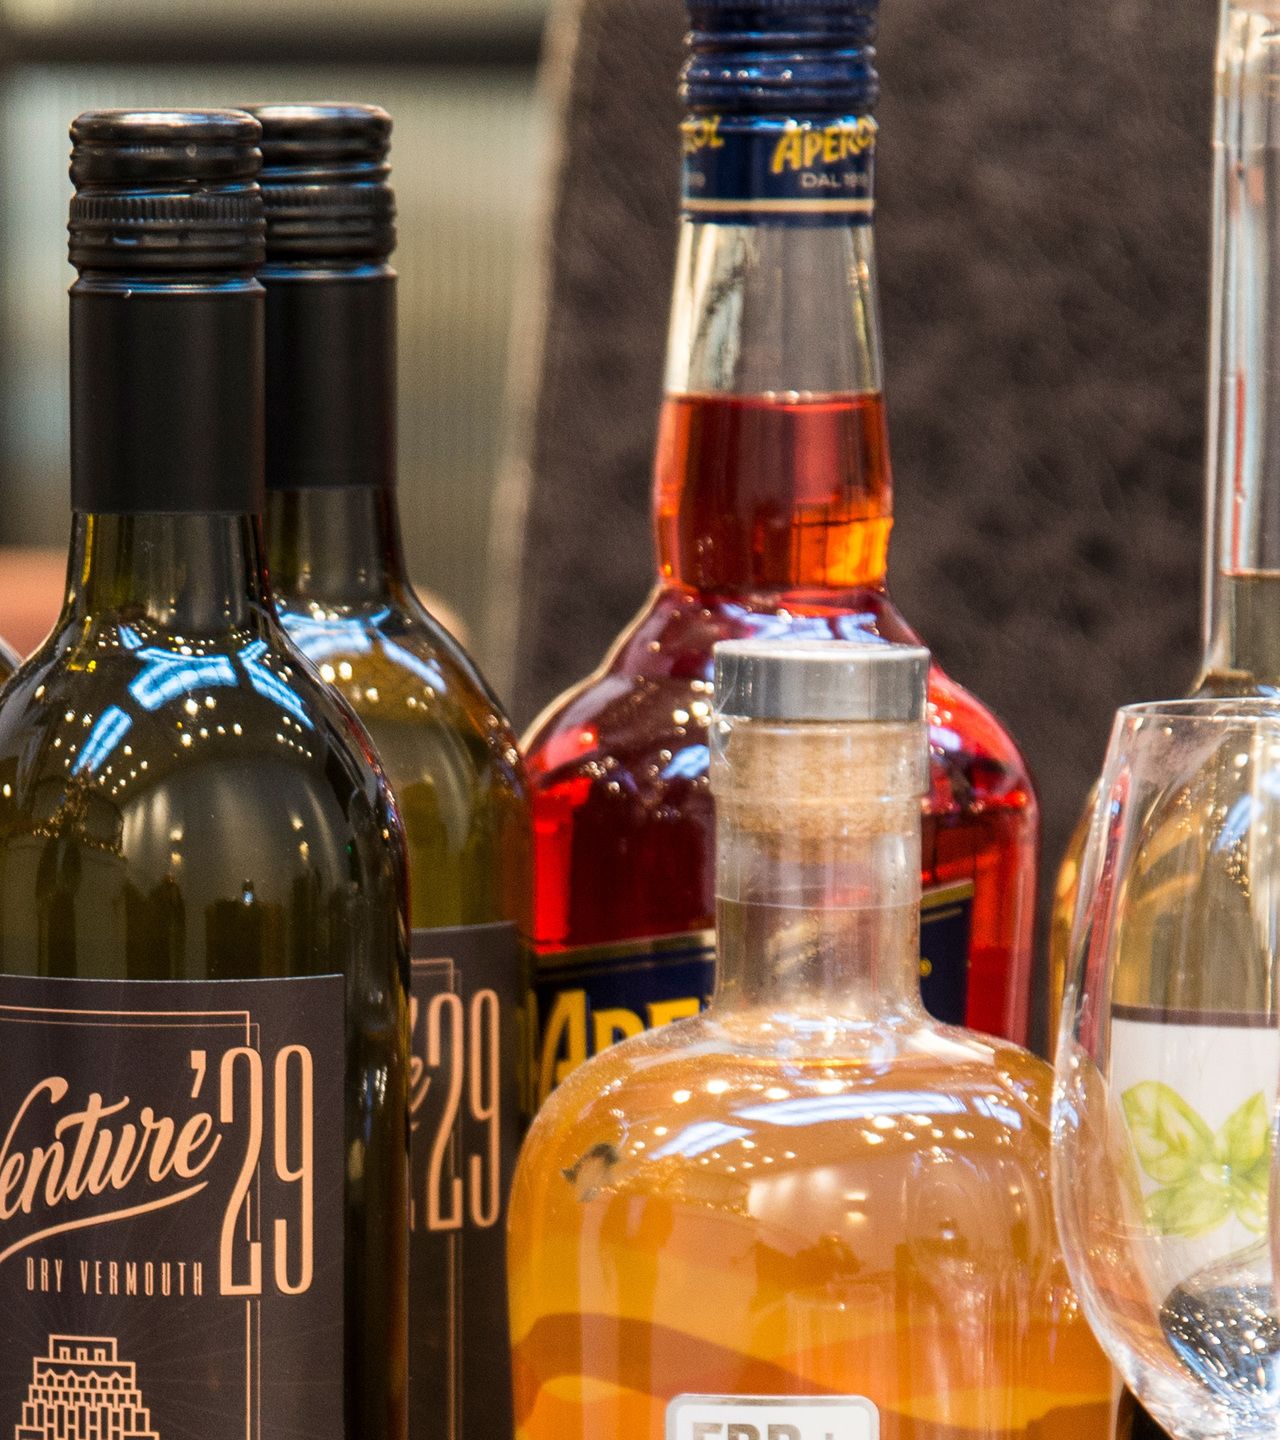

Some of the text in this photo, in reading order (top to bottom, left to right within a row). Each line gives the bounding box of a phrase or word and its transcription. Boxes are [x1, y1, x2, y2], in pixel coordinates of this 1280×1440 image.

[800, 172, 841, 188] DAL
[26, 1256, 203, 1296] DRY VERMOUTH
